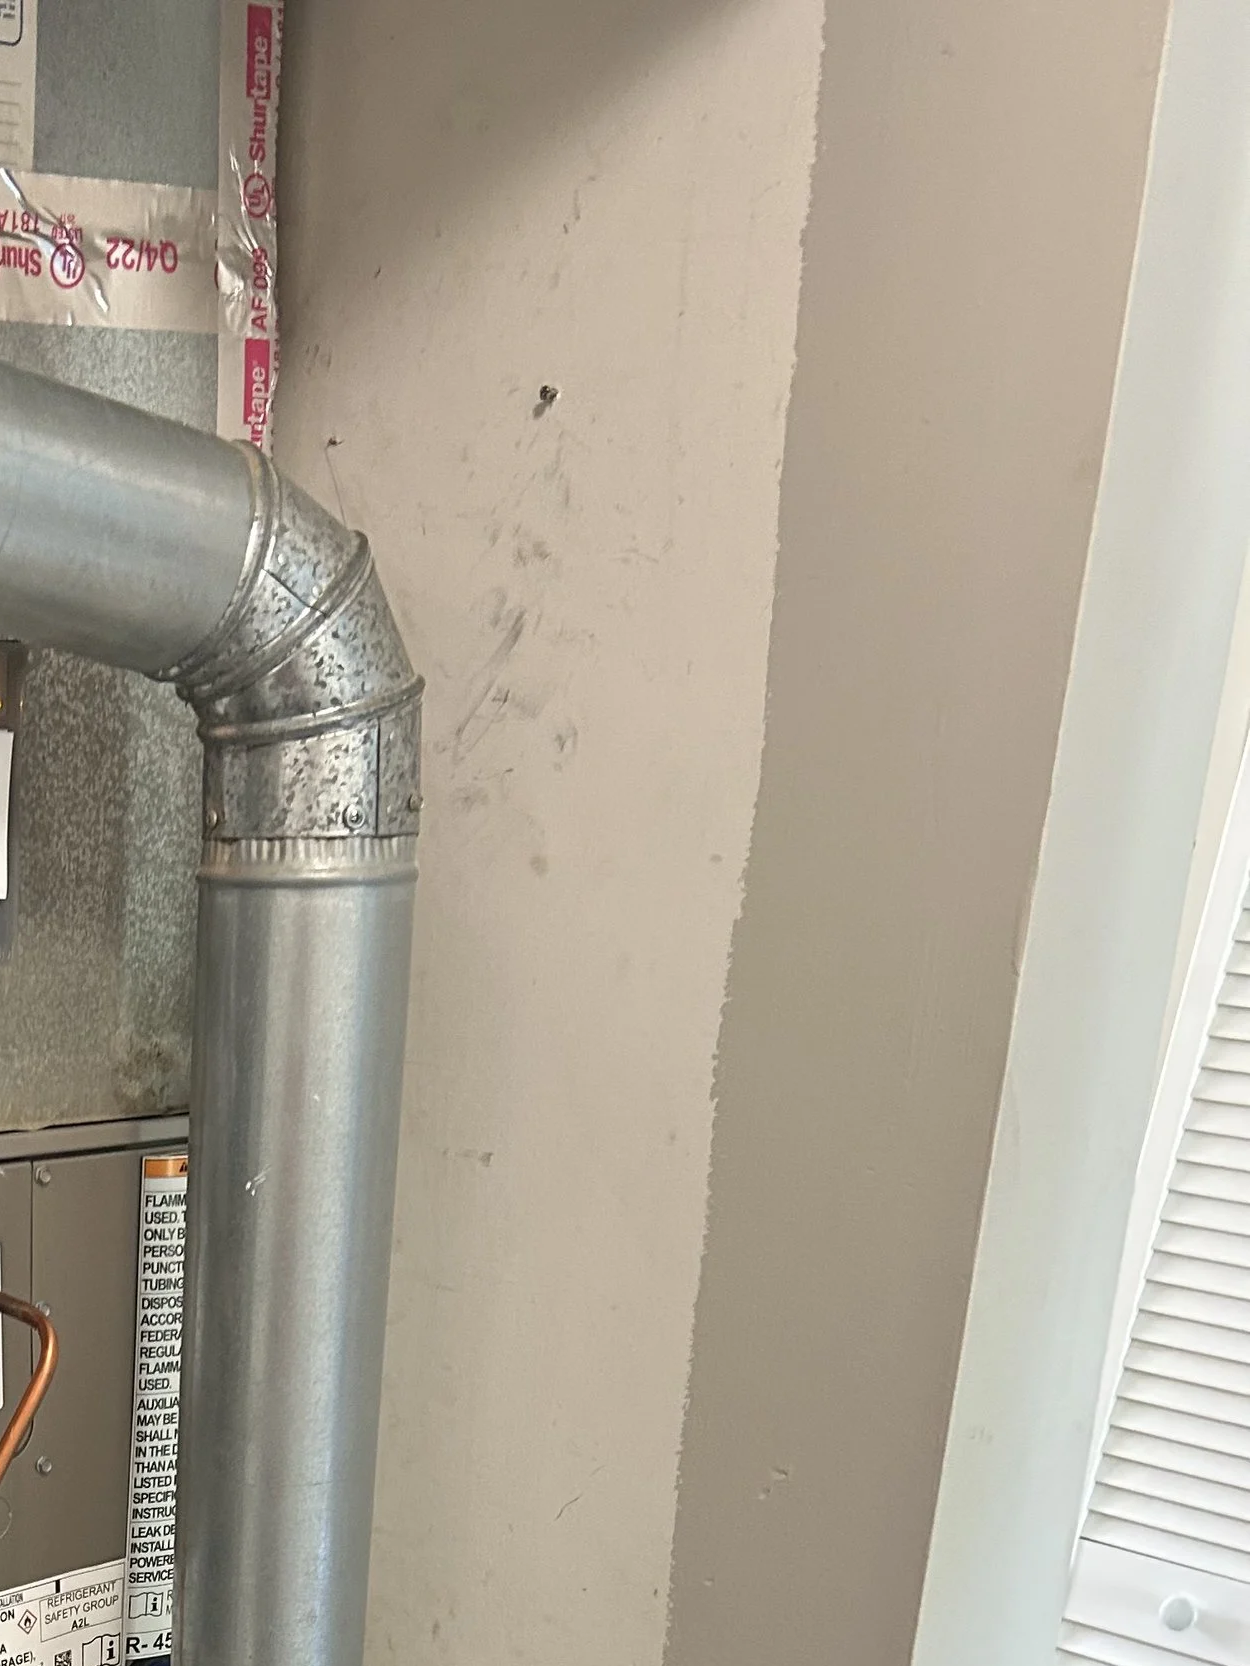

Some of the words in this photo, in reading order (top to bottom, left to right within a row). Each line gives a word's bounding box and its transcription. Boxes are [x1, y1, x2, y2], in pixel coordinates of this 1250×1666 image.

[249, 35, 267, 163] Shurtape
[104, 236, 179, 275] Q4/22
[251, 296, 268, 333] AF
[145, 1211, 180, 1224] USED.
[144, 1228, 176, 1241] ONLY
[143, 1244, 184, 1258] PERSO
[143, 1261, 184, 1275] PUNCT
[142, 1277, 184, 1291] TUBING
[141, 1296, 183, 1310] DISPOS
[140, 1312, 182, 1326] ACCOR
[139, 1361, 181, 1375] FLAMM
[138, 1378, 172, 1391] USED.
[137, 1397, 179, 1410] AUXILIA
[136, 1413, 162, 1427] MAY
[163, 1413, 177, 1425] BE
[136, 1428, 172, 1442] SHALL
[135, 1446, 147, 1458] IN
[149, 1444, 171, 1457] THE
[134, 1460, 166, 1474] THAN
[134, 1475, 172, 1489] LISTED
[131, 1525, 162, 1539] LEAK
[129, 1568, 174, 1583] SERVICE
[47, 1581, 117, 1609] REFRIGERANT
[44, 1605, 80, 1625] SAFETY
[83, 1594, 119, 1613] GROUP
[71, 1616, 90, 1631] A2L
